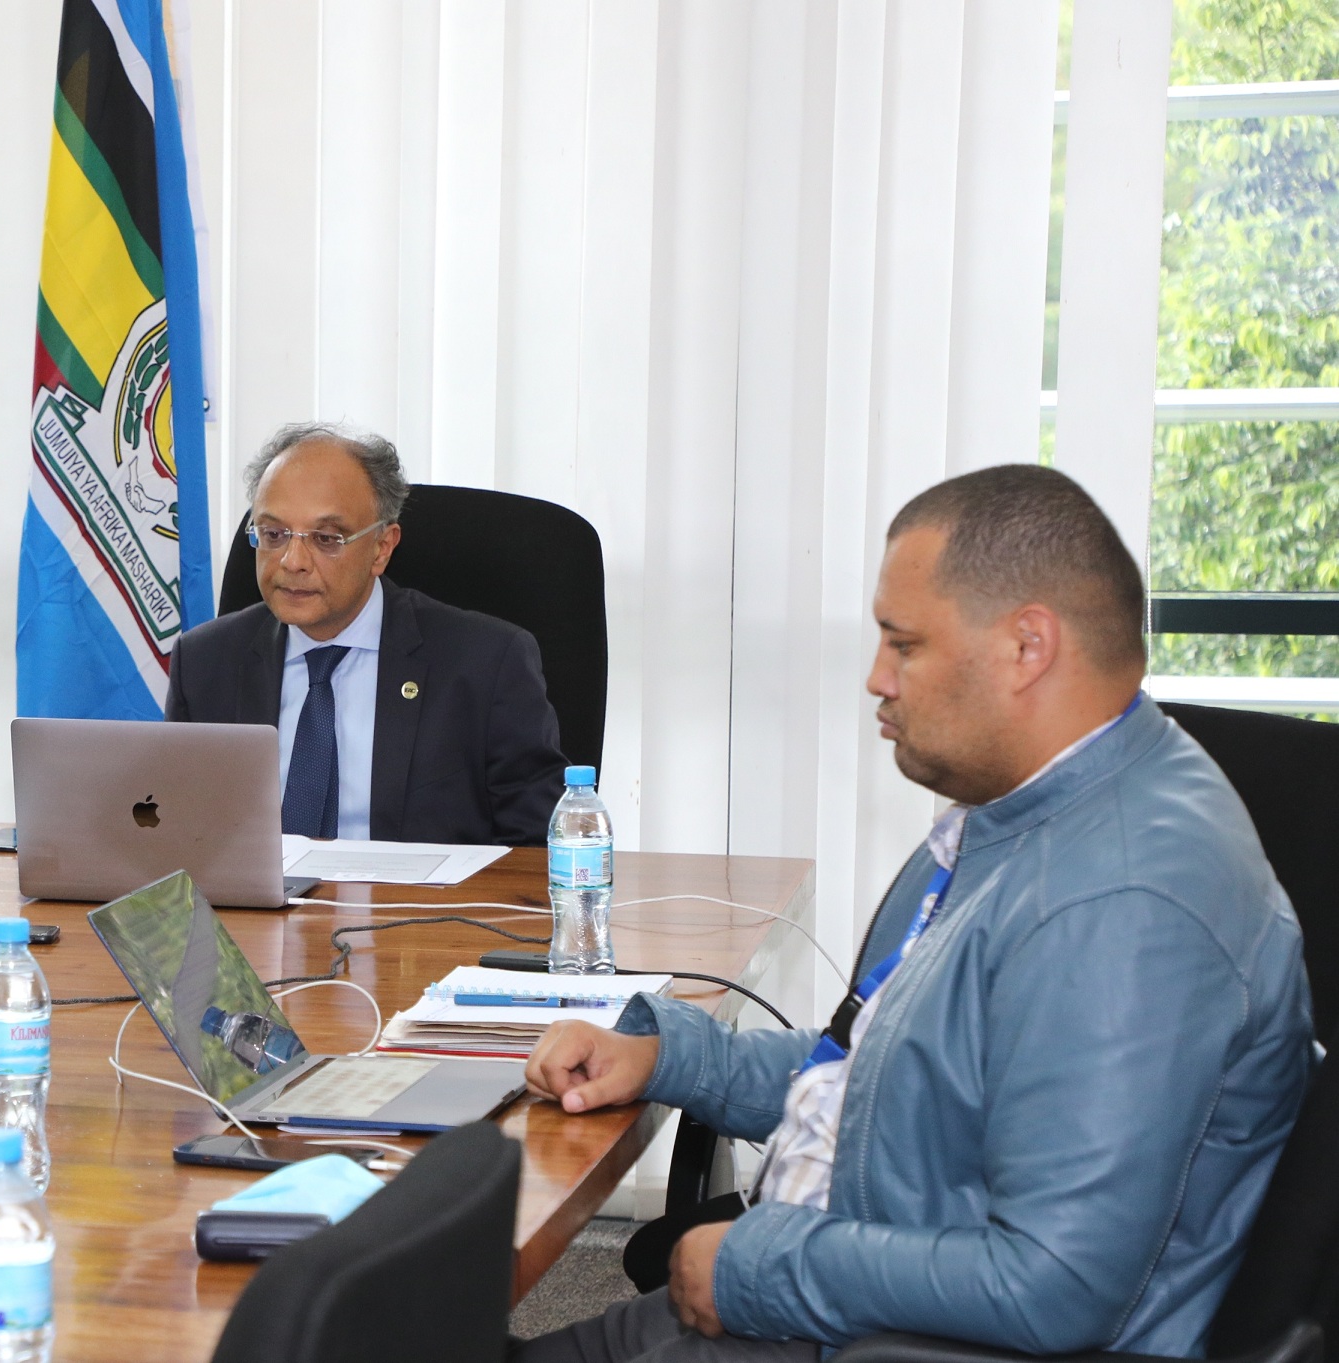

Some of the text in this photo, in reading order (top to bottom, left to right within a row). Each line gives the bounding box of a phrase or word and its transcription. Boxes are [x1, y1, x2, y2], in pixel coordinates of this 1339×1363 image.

[40, 418, 174, 623] JUMUIYA YA AFRIKA MASHARIKI
